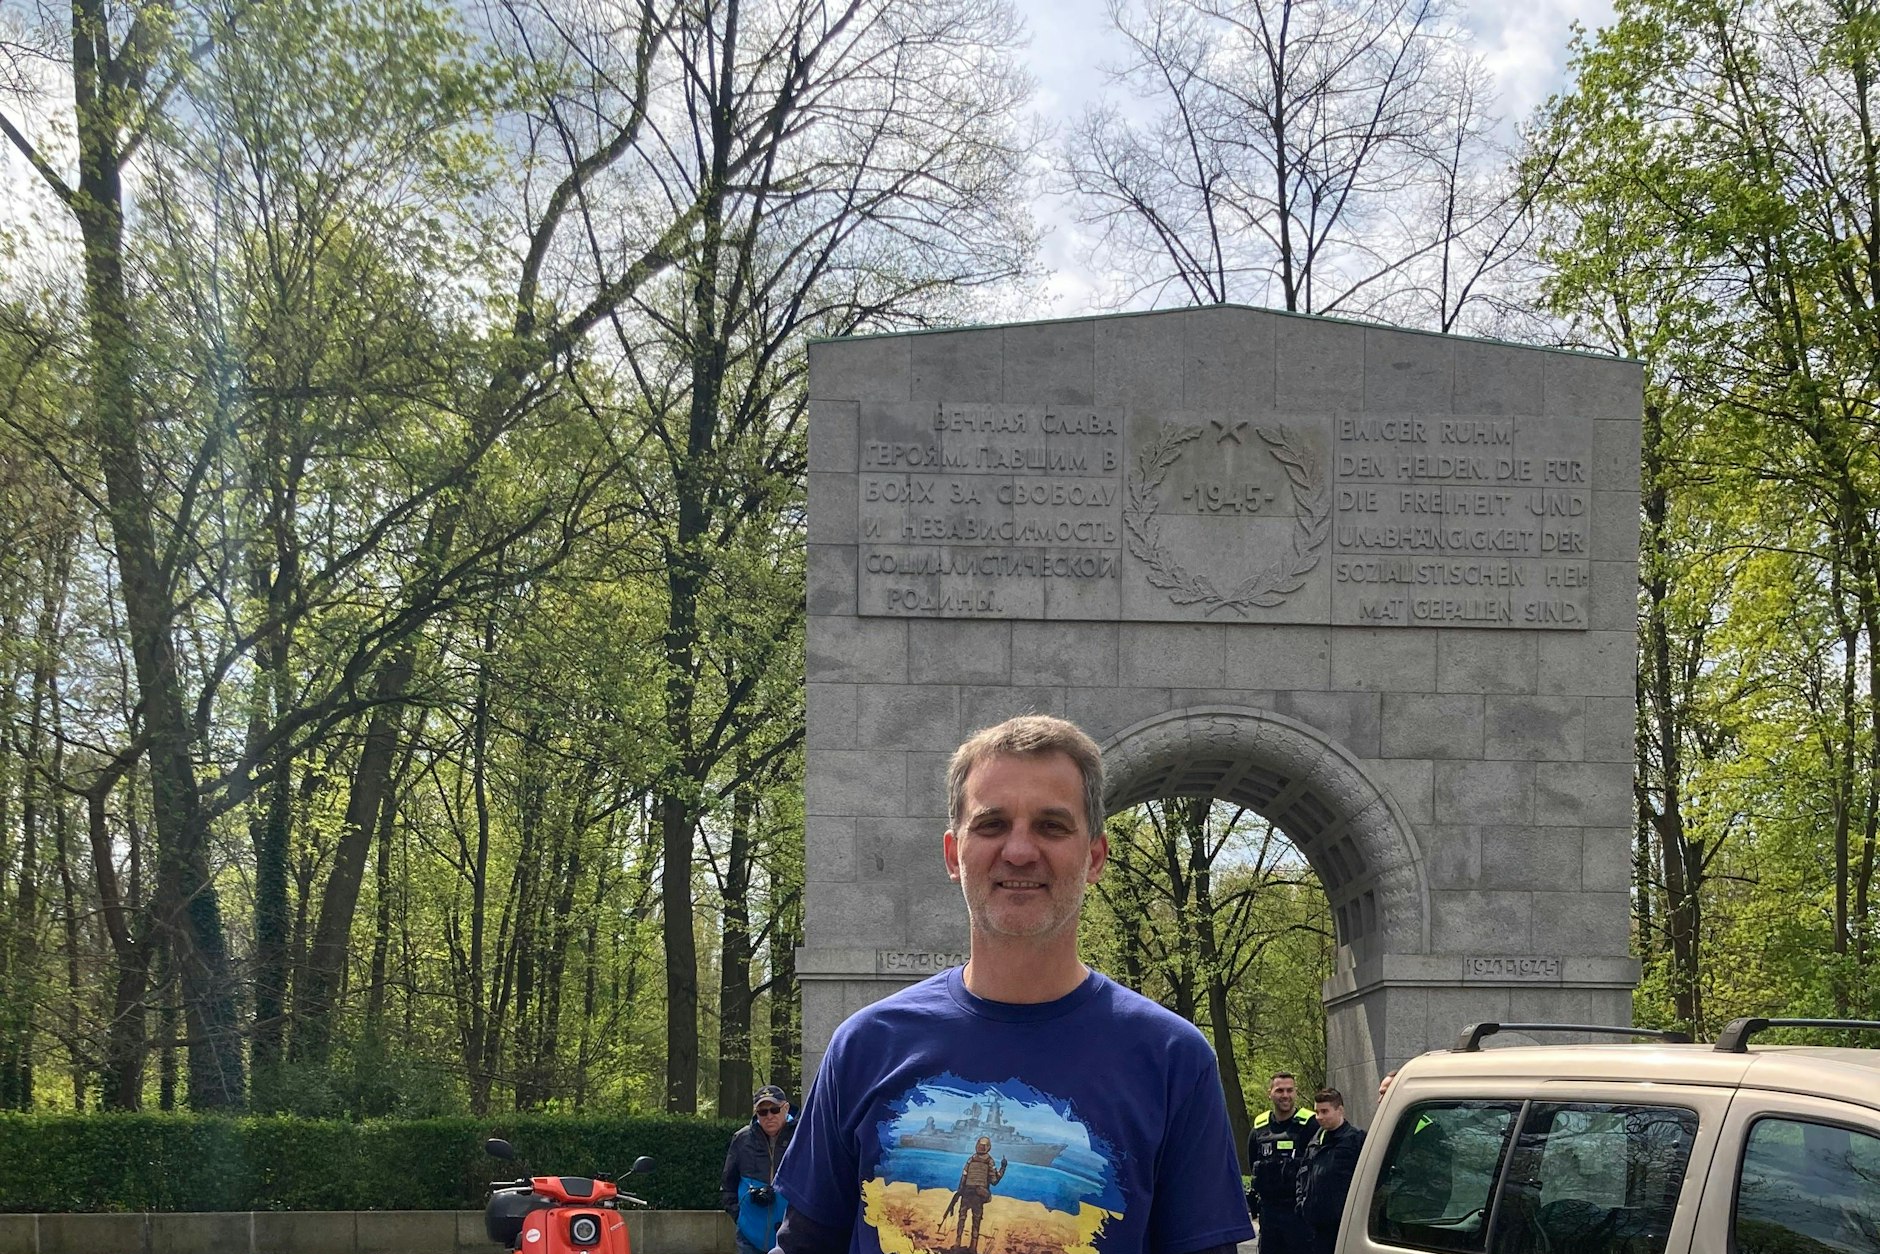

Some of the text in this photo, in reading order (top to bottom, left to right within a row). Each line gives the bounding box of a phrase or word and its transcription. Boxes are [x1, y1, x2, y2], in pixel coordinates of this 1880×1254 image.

[934, 410, 1118, 435] ВЕЧНАЯ СЛАВА
[1339, 420, 1512, 446] EWIGER RUHM
[976, 446, 1087, 471] ПАВШИМ
[1103, 447, 1117, 471] В
[1339, 455, 1385, 478] DEN
[1494, 458, 1533, 481] DIE
[1544, 457, 1586, 483] FÜR
[865, 479, 1117, 507] БОЯХ ЗА СВОБОДУ
[1338, 489, 1585, 517] DIE FREIHEIT UND
[866, 516, 1117, 543] И НЕЗАВИСИМОСТЬ
[1337, 525, 1584, 553] UNABHÄNGIGKEIT DER
[865, 553, 1116, 579] СОЦИАЛИСТИЧЕСКОЙ
[1336, 563, 1525, 587] SOZIALISTISCHEN
[1359, 598, 1583, 624] MAT GEFALLEN SIND.
